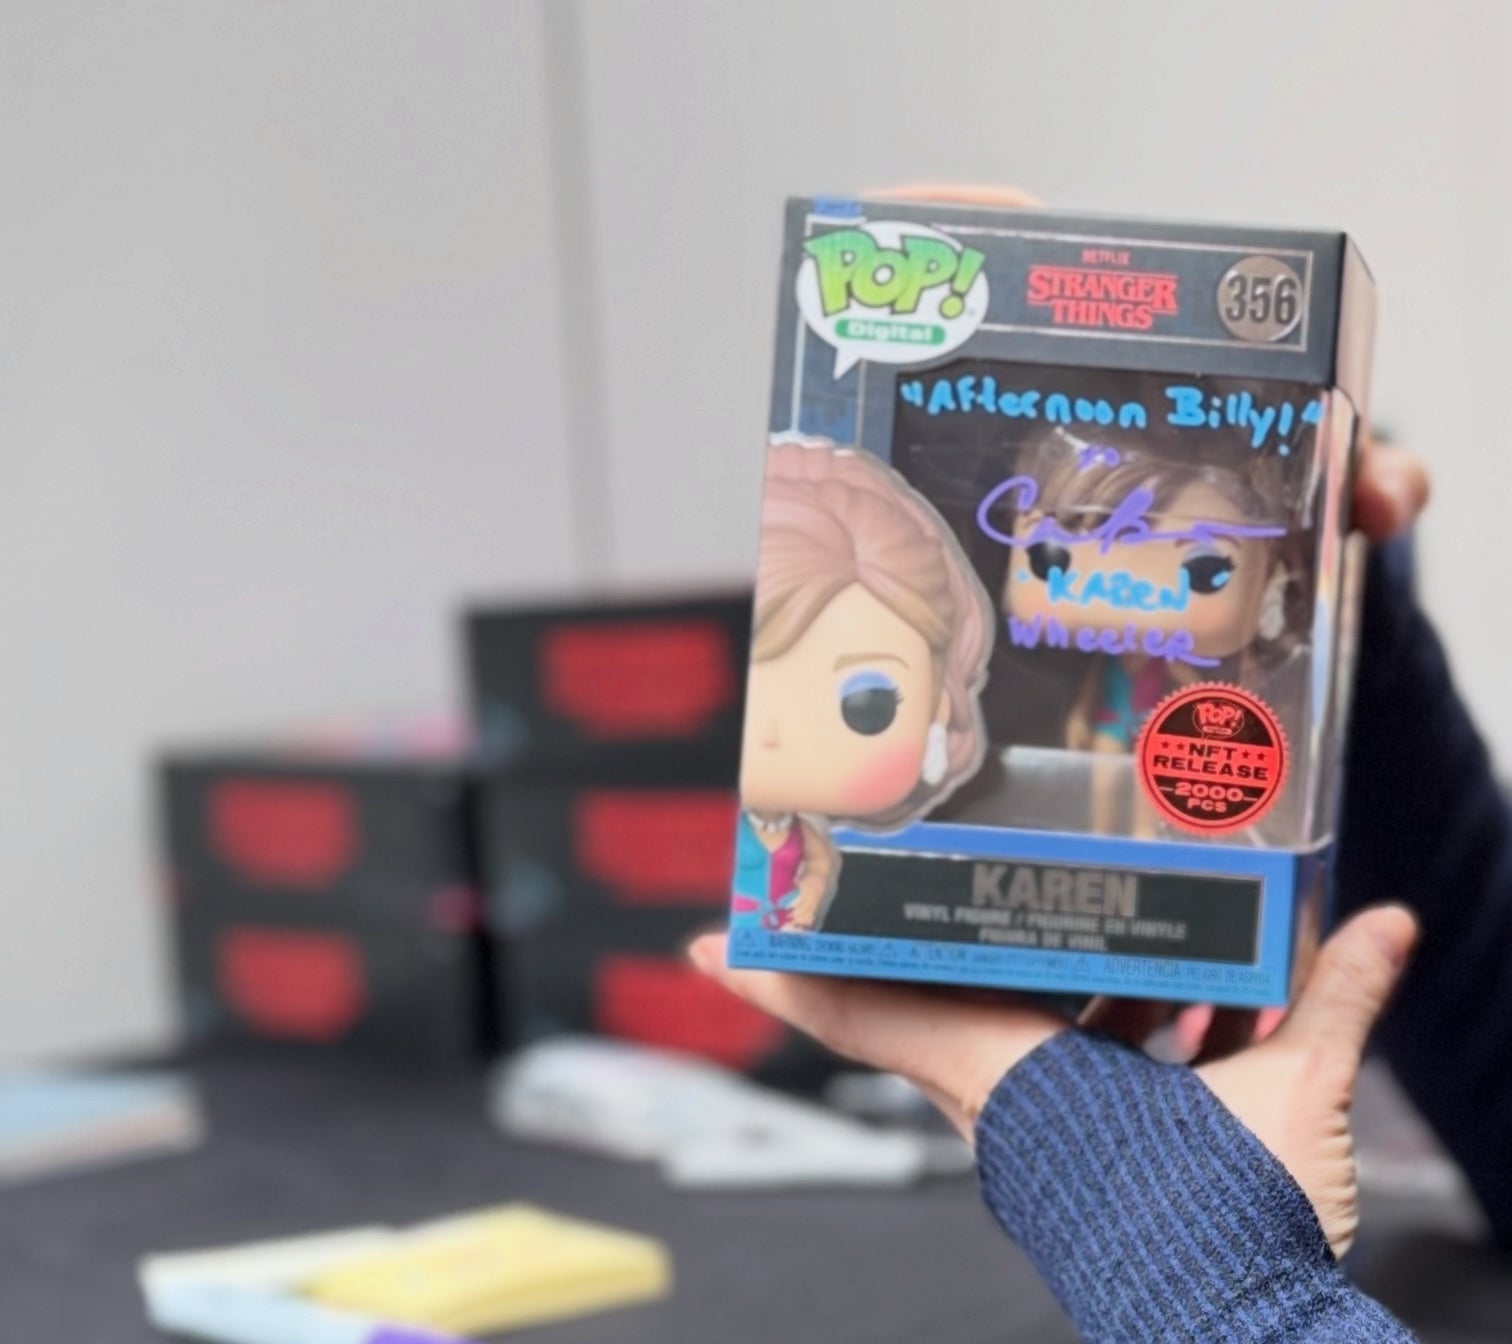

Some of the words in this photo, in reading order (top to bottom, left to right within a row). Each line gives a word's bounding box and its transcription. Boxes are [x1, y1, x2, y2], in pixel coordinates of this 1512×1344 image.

[803, 228, 986, 321] POP!
[1027, 265, 1178, 315] STRANGER
[1225, 273, 1298, 325] 356
[1053, 300, 1153, 330] THINGS
[846, 320, 933, 344] Digital
[1196, 702, 1241, 727] POP!
[1188, 742, 1237, 761] NFT
[1153, 754, 1269, 781] RELEASE
[1174, 782, 1244, 802] 2000
[1186, 797, 1227, 813] PCS
[972, 863, 1138, 917] KAREN
[904, 902, 949, 923] VINYL
[1104, 919, 1126, 937] EN
[1129, 920, 1188, 941] VINYLE
[1043, 931, 1066, 949] DE
